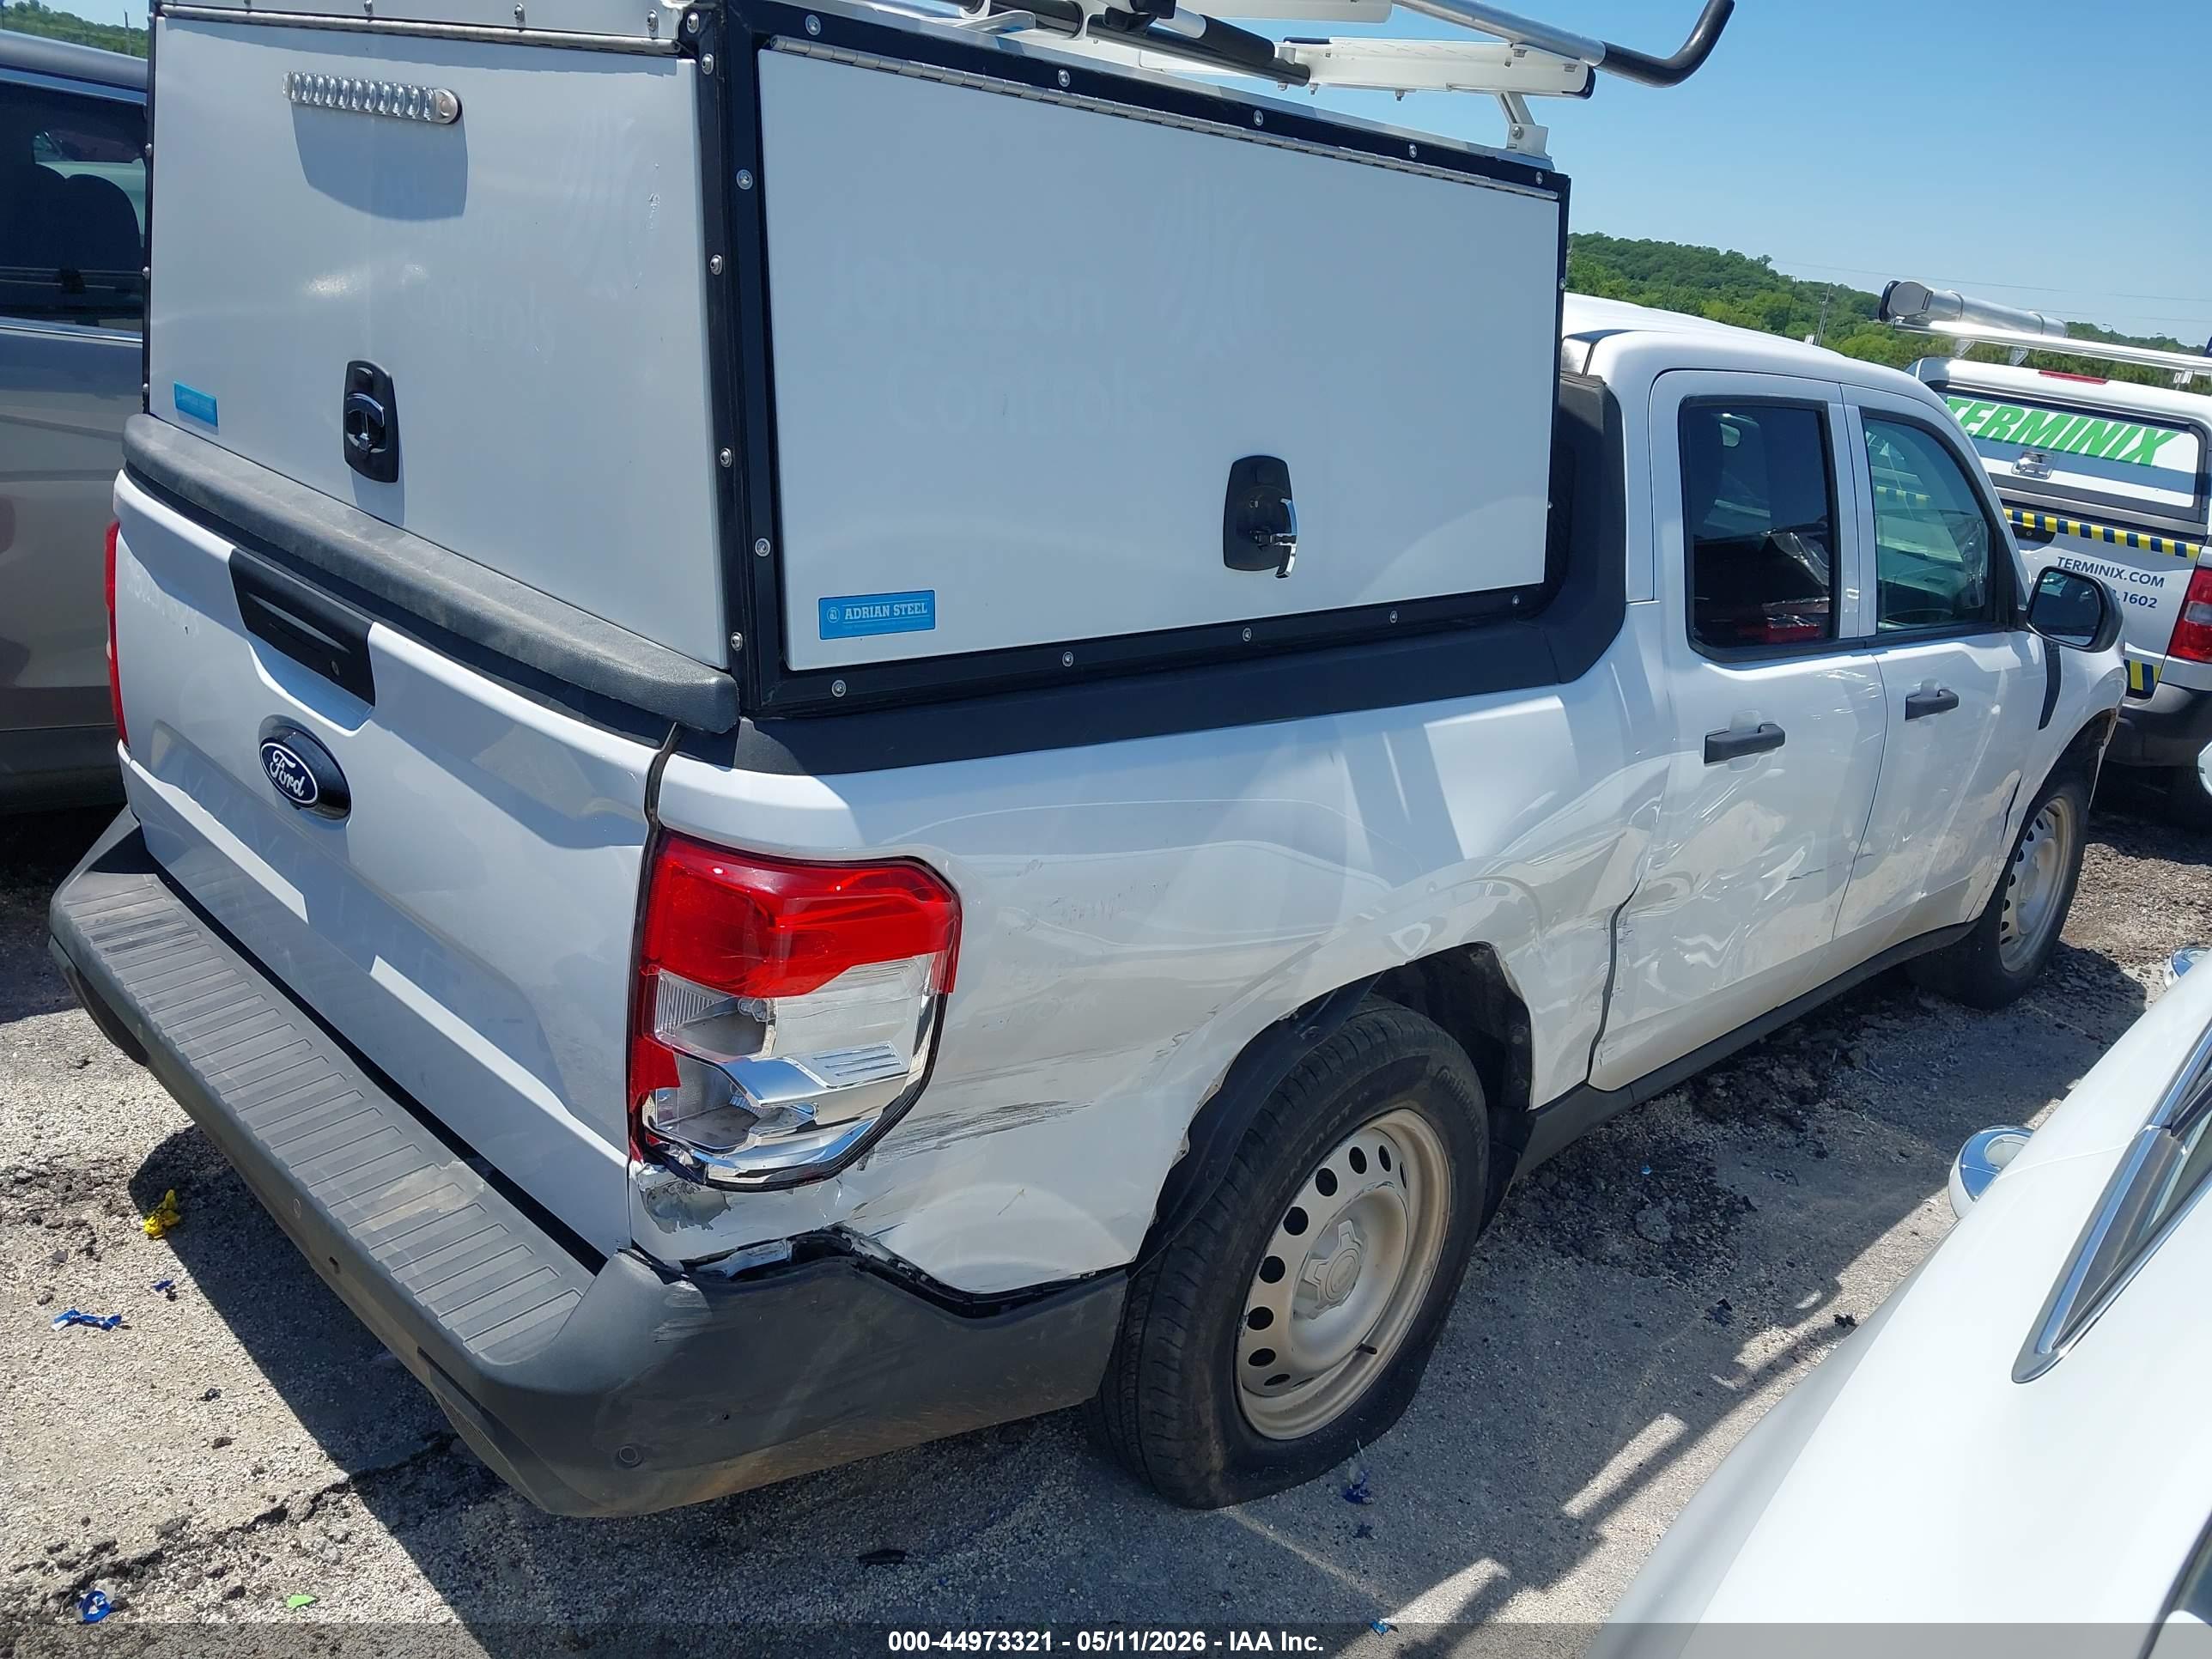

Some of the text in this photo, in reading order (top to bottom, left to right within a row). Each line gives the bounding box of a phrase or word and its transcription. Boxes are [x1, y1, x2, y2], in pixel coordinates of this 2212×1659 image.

[1947, 397, 2181, 466] TERMINIX
[2057, 556, 2166, 588] TERMINIX.COM
[844, 602, 928, 620] ADRIAN STEEL
[269, 749, 307, 798] Ford
